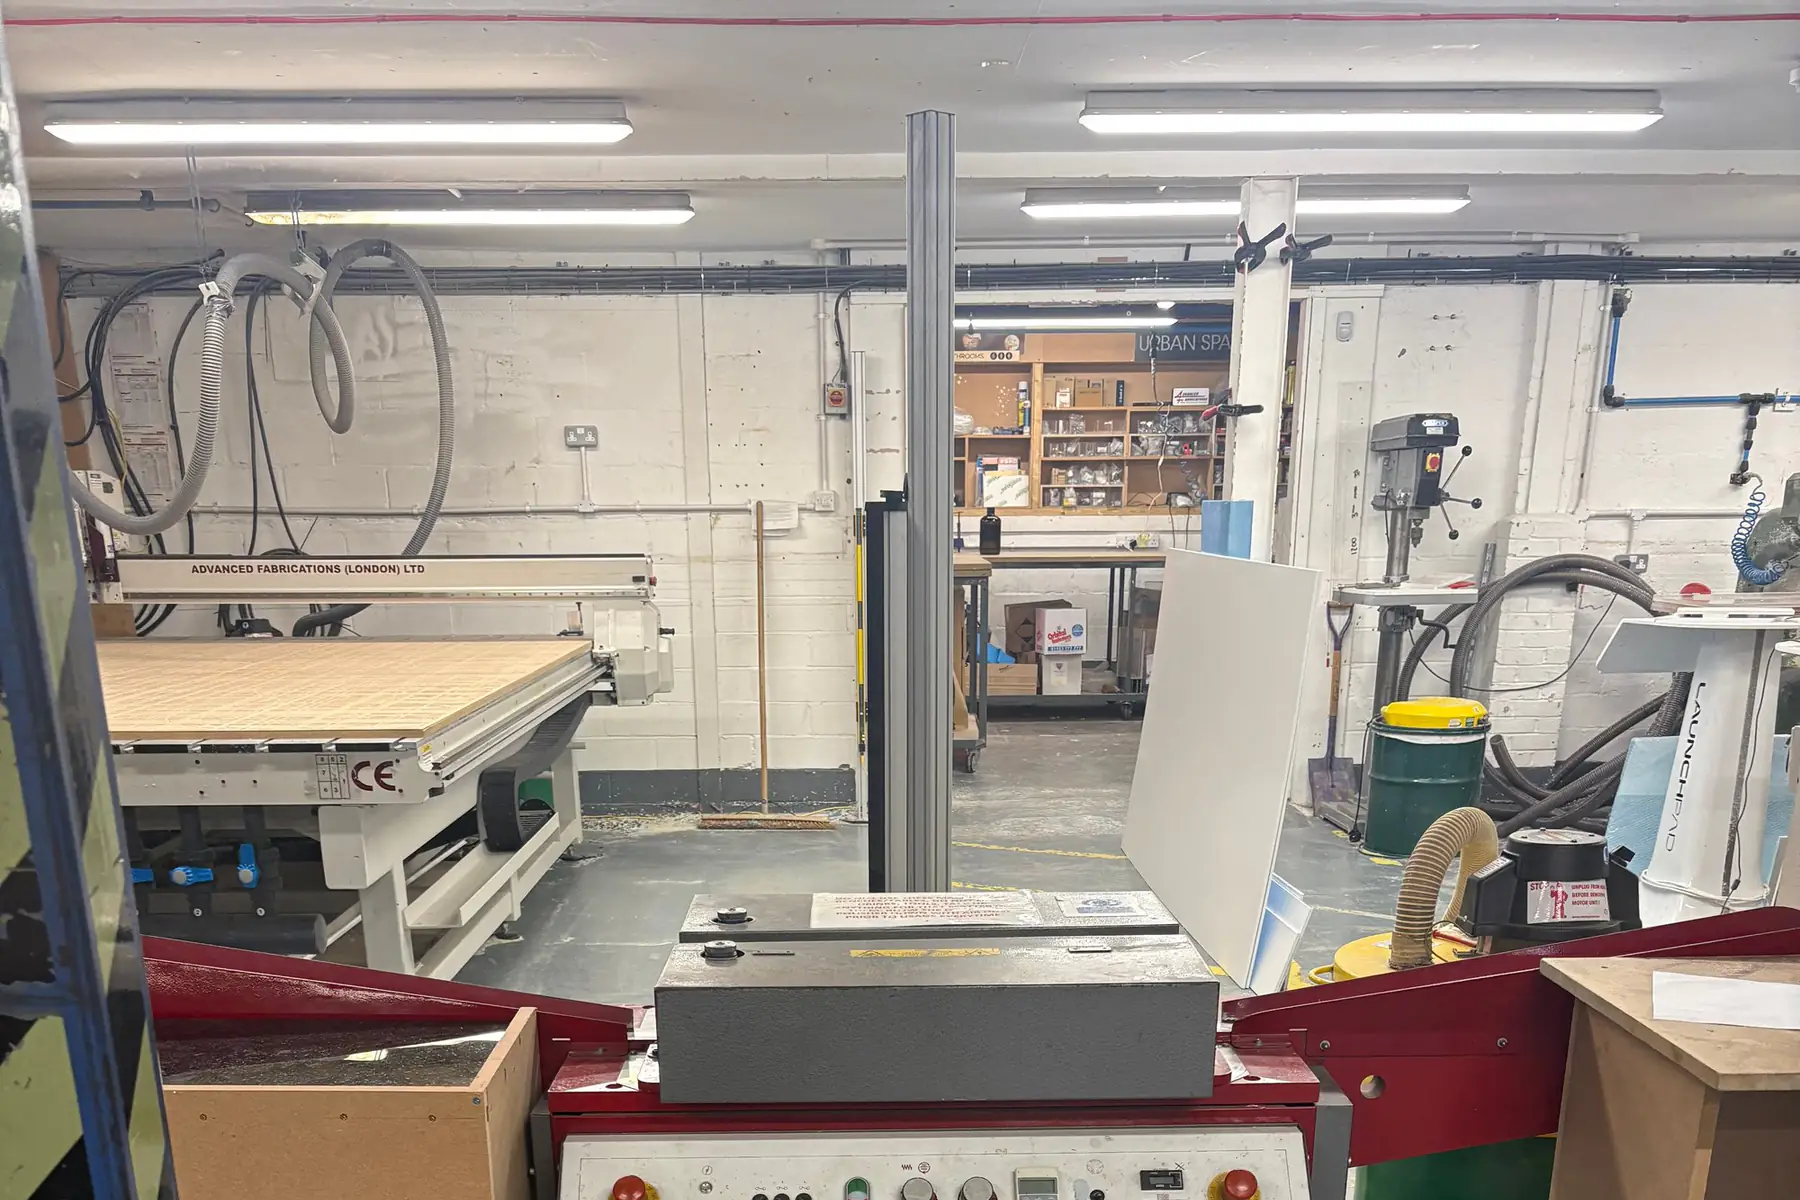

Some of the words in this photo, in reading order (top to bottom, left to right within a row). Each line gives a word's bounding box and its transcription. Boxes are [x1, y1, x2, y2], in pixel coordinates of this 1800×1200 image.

[1139, 334, 1196, 351] URBAN
[1350, 537, 1358, 555] 1200
[191, 564, 254, 574] ADVANCED
[257, 564, 341, 574] FABRICATIONS
[344, 564, 401, 576] (LONDON)
[403, 564, 425, 574] LTD
[351, 760, 396, 791] CE
[1665, 682, 1706, 852] LAUNCHPAD
